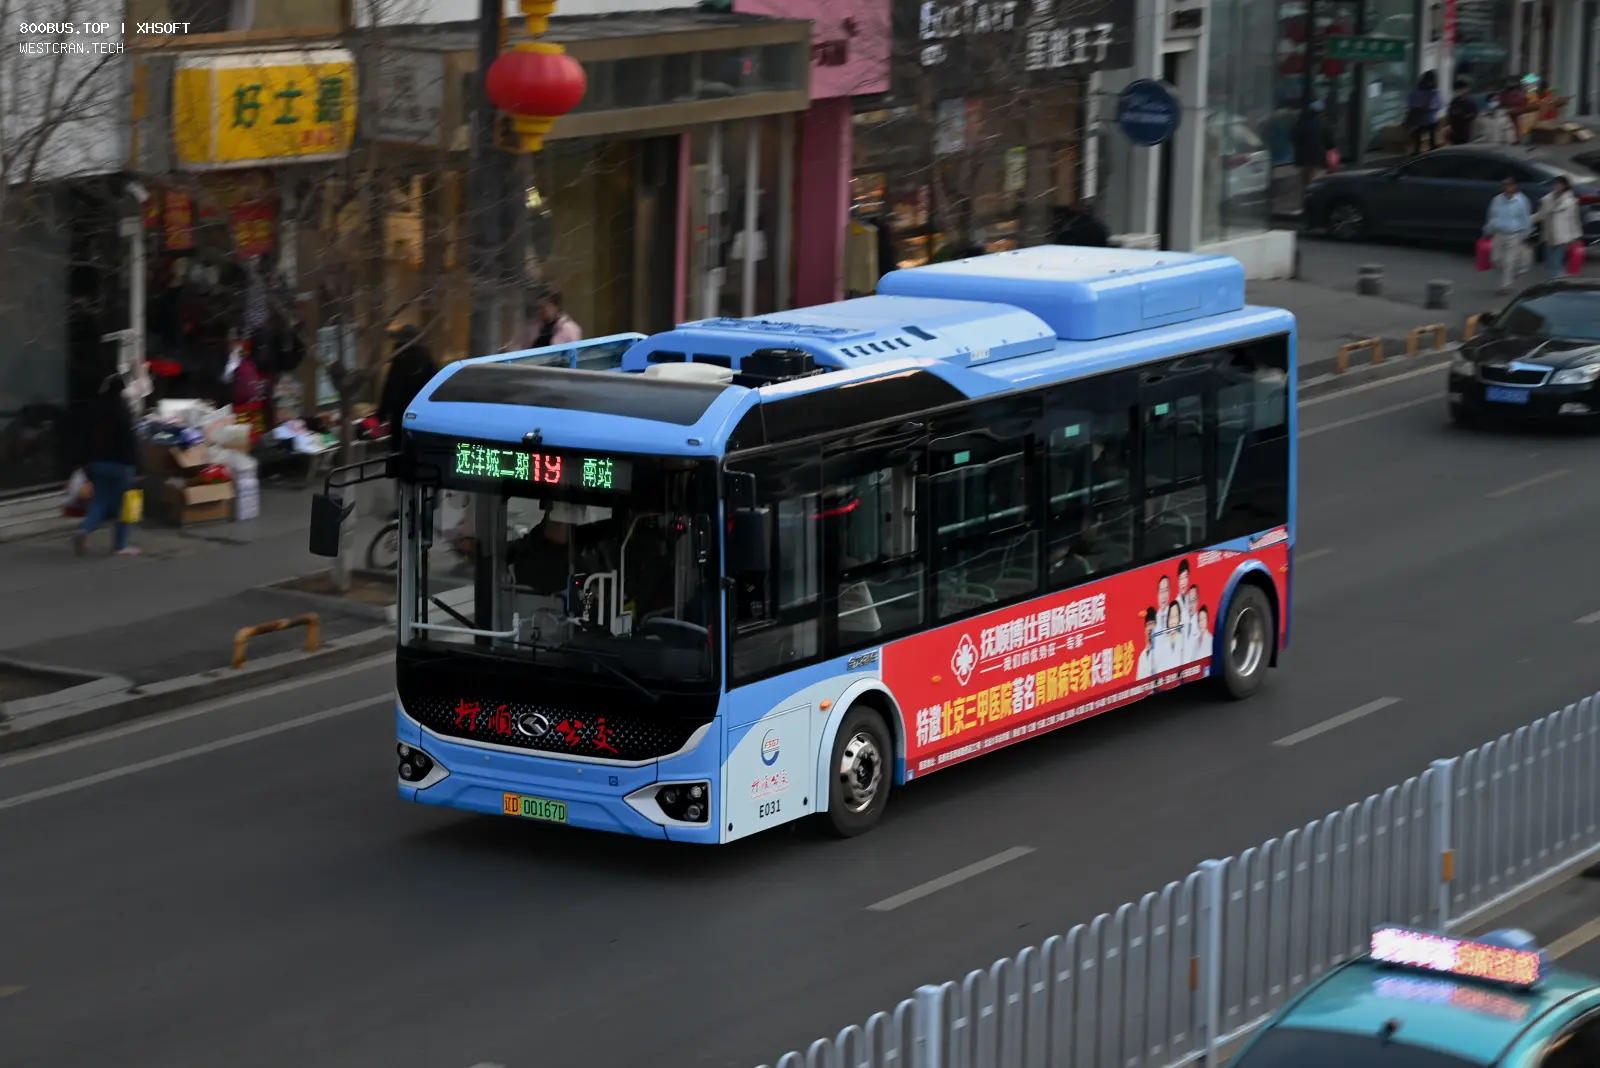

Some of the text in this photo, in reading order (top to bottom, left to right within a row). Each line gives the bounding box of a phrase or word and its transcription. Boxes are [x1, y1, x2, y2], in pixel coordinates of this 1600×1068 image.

[532, 453, 562, 484] 19
[582, 458, 613, 489] 南站
[980, 592, 1106, 660] 抚顺博仕胃肠病医院
[523, 799, 565, 820] 00167D
[759, 799, 781, 818] E031
